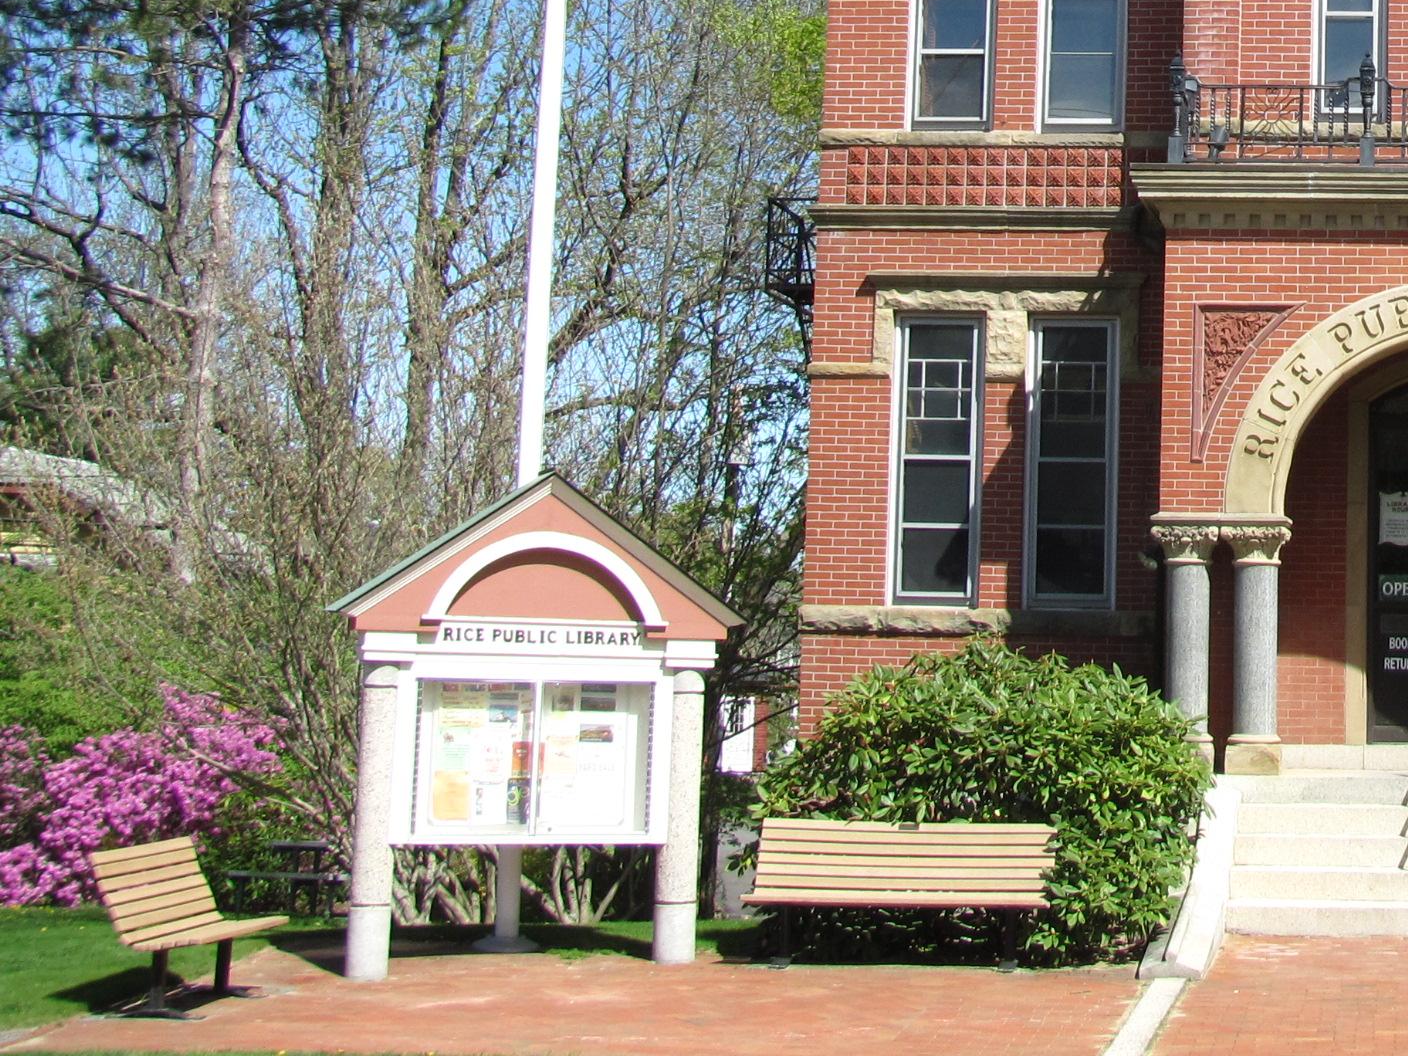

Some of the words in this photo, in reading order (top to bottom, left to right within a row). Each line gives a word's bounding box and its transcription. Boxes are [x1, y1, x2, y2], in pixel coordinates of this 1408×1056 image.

[1243, 352, 1323, 464] RICE
[443, 628, 484, 642] RICE
[492, 629, 557, 644] PUBLIC
[566, 631, 641, 646] LIBRARY
